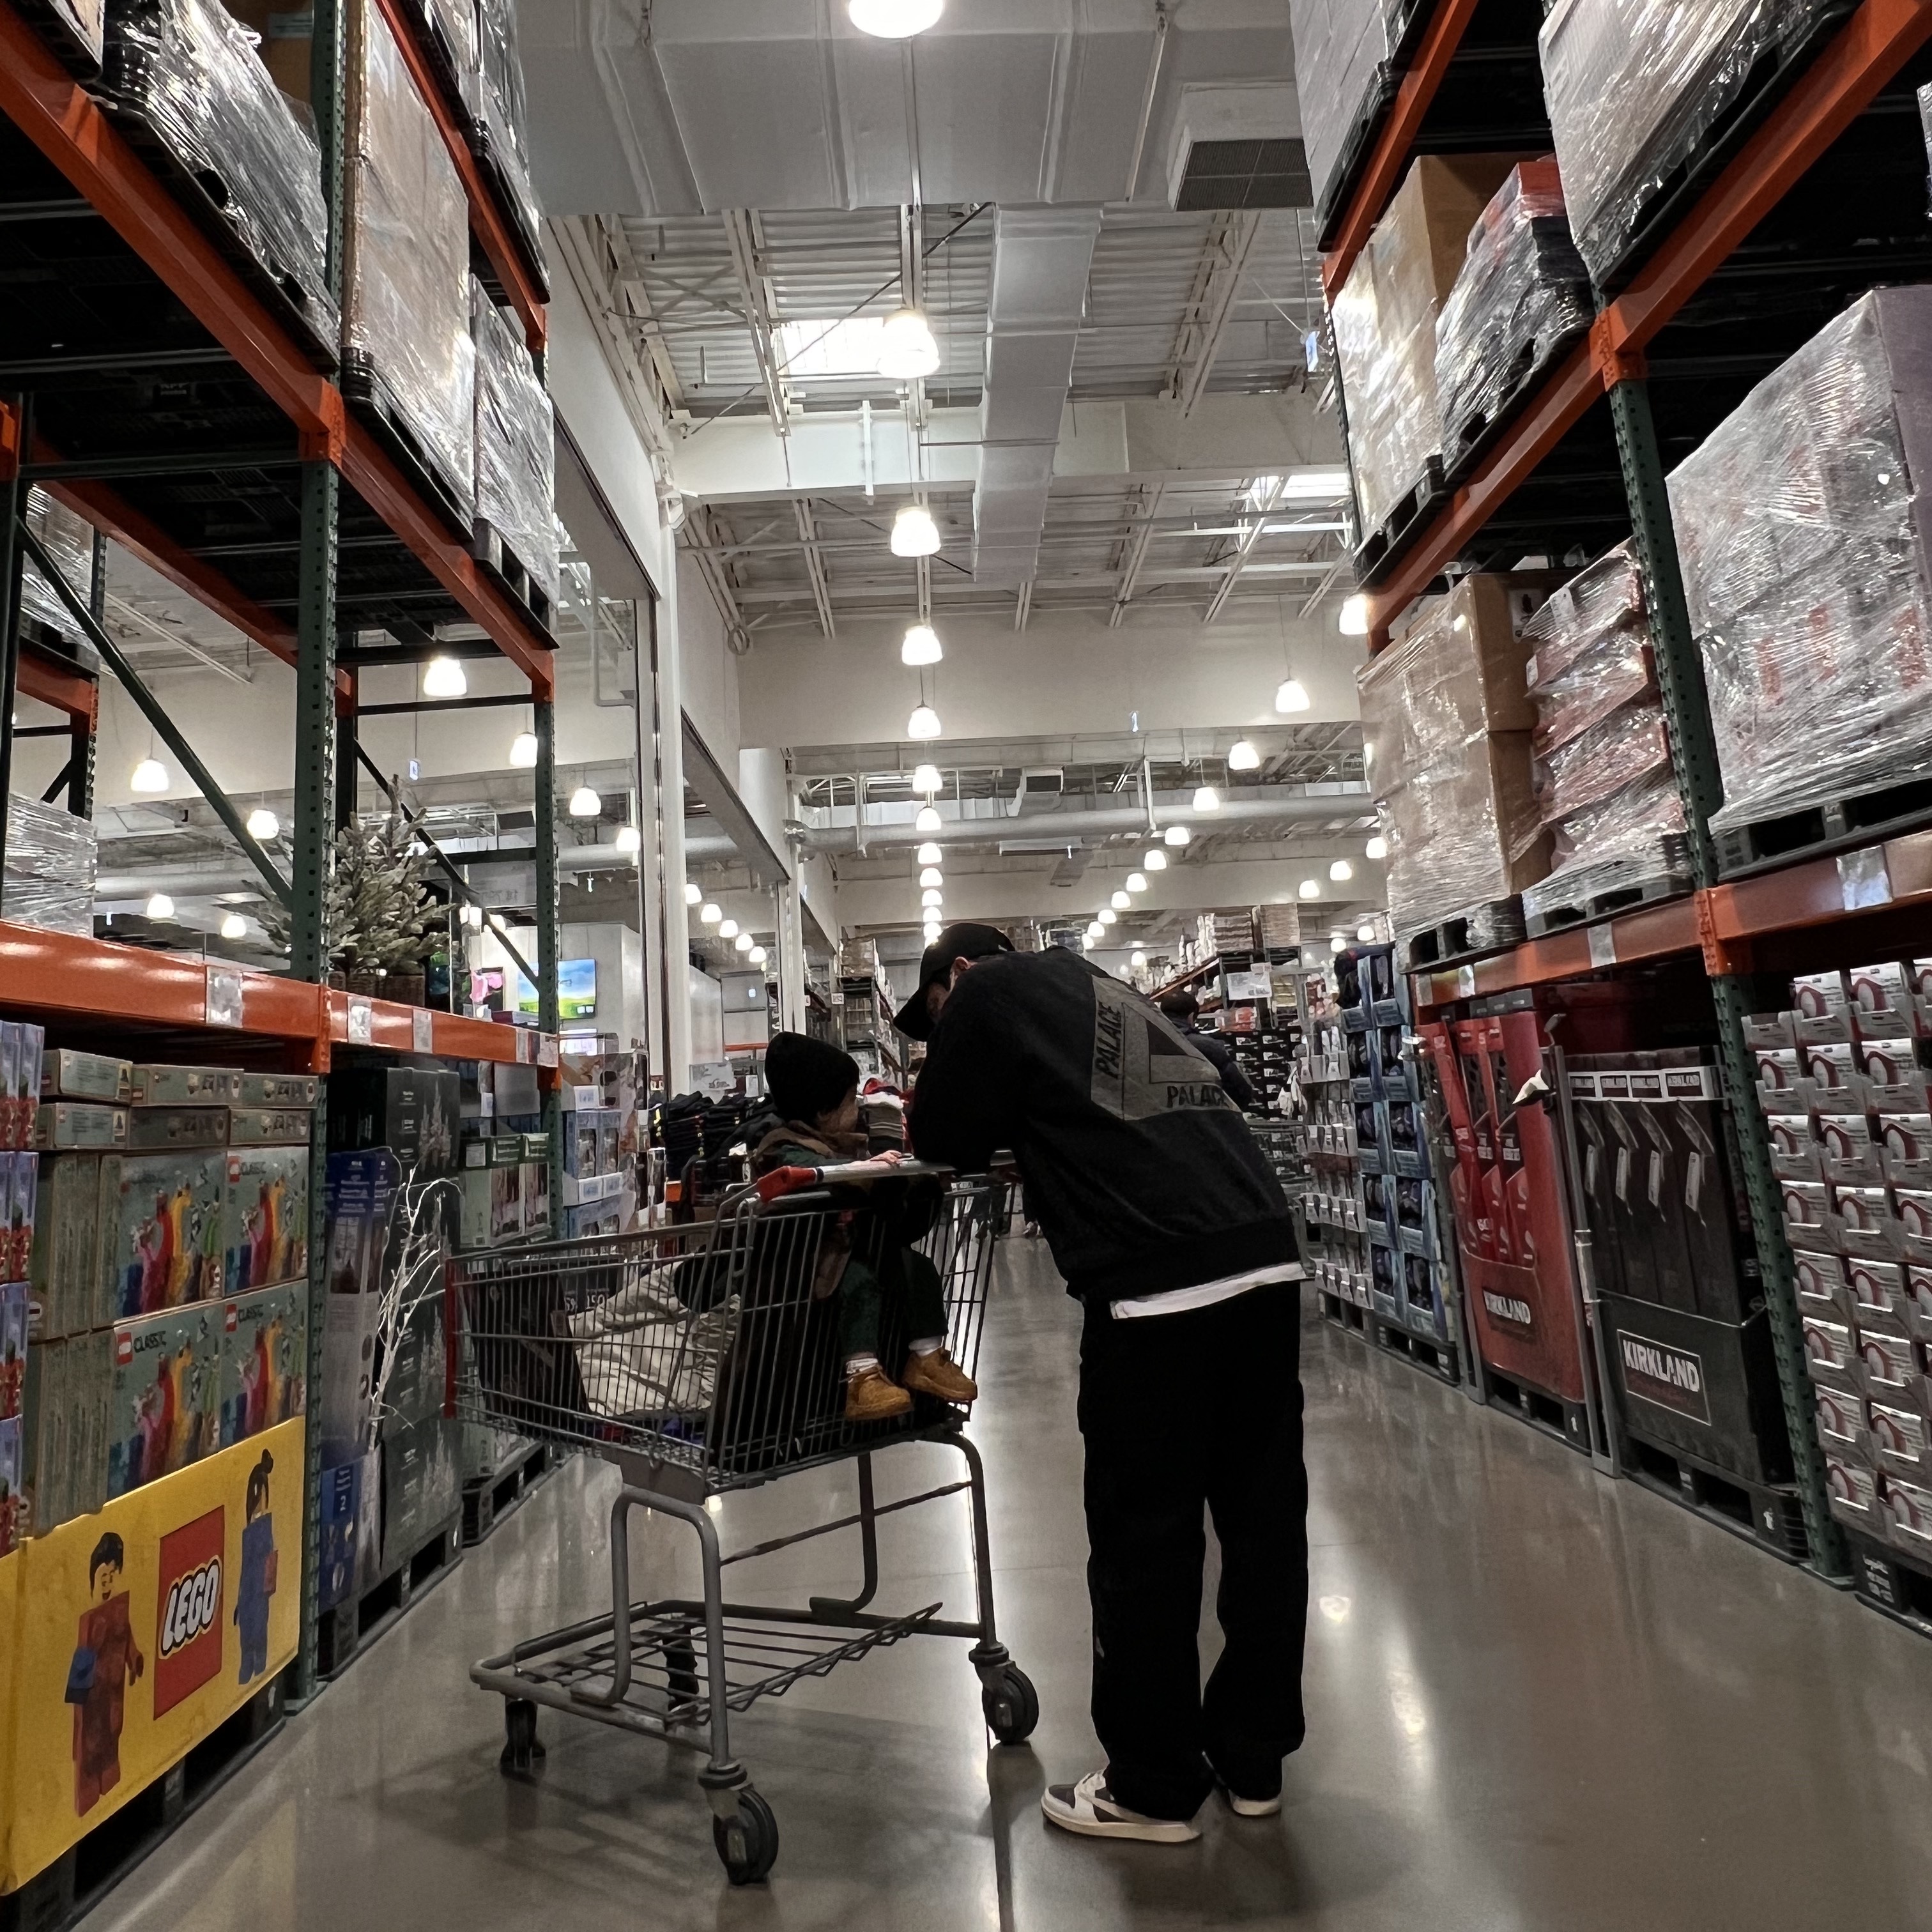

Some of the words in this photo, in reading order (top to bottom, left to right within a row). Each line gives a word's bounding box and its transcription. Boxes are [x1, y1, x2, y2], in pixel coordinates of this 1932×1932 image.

[1095, 1001, 1122, 1080] PALACE
[1623, 1339, 1700, 1392] KIRKLAND
[162, 1564, 220, 1652] LEGO
